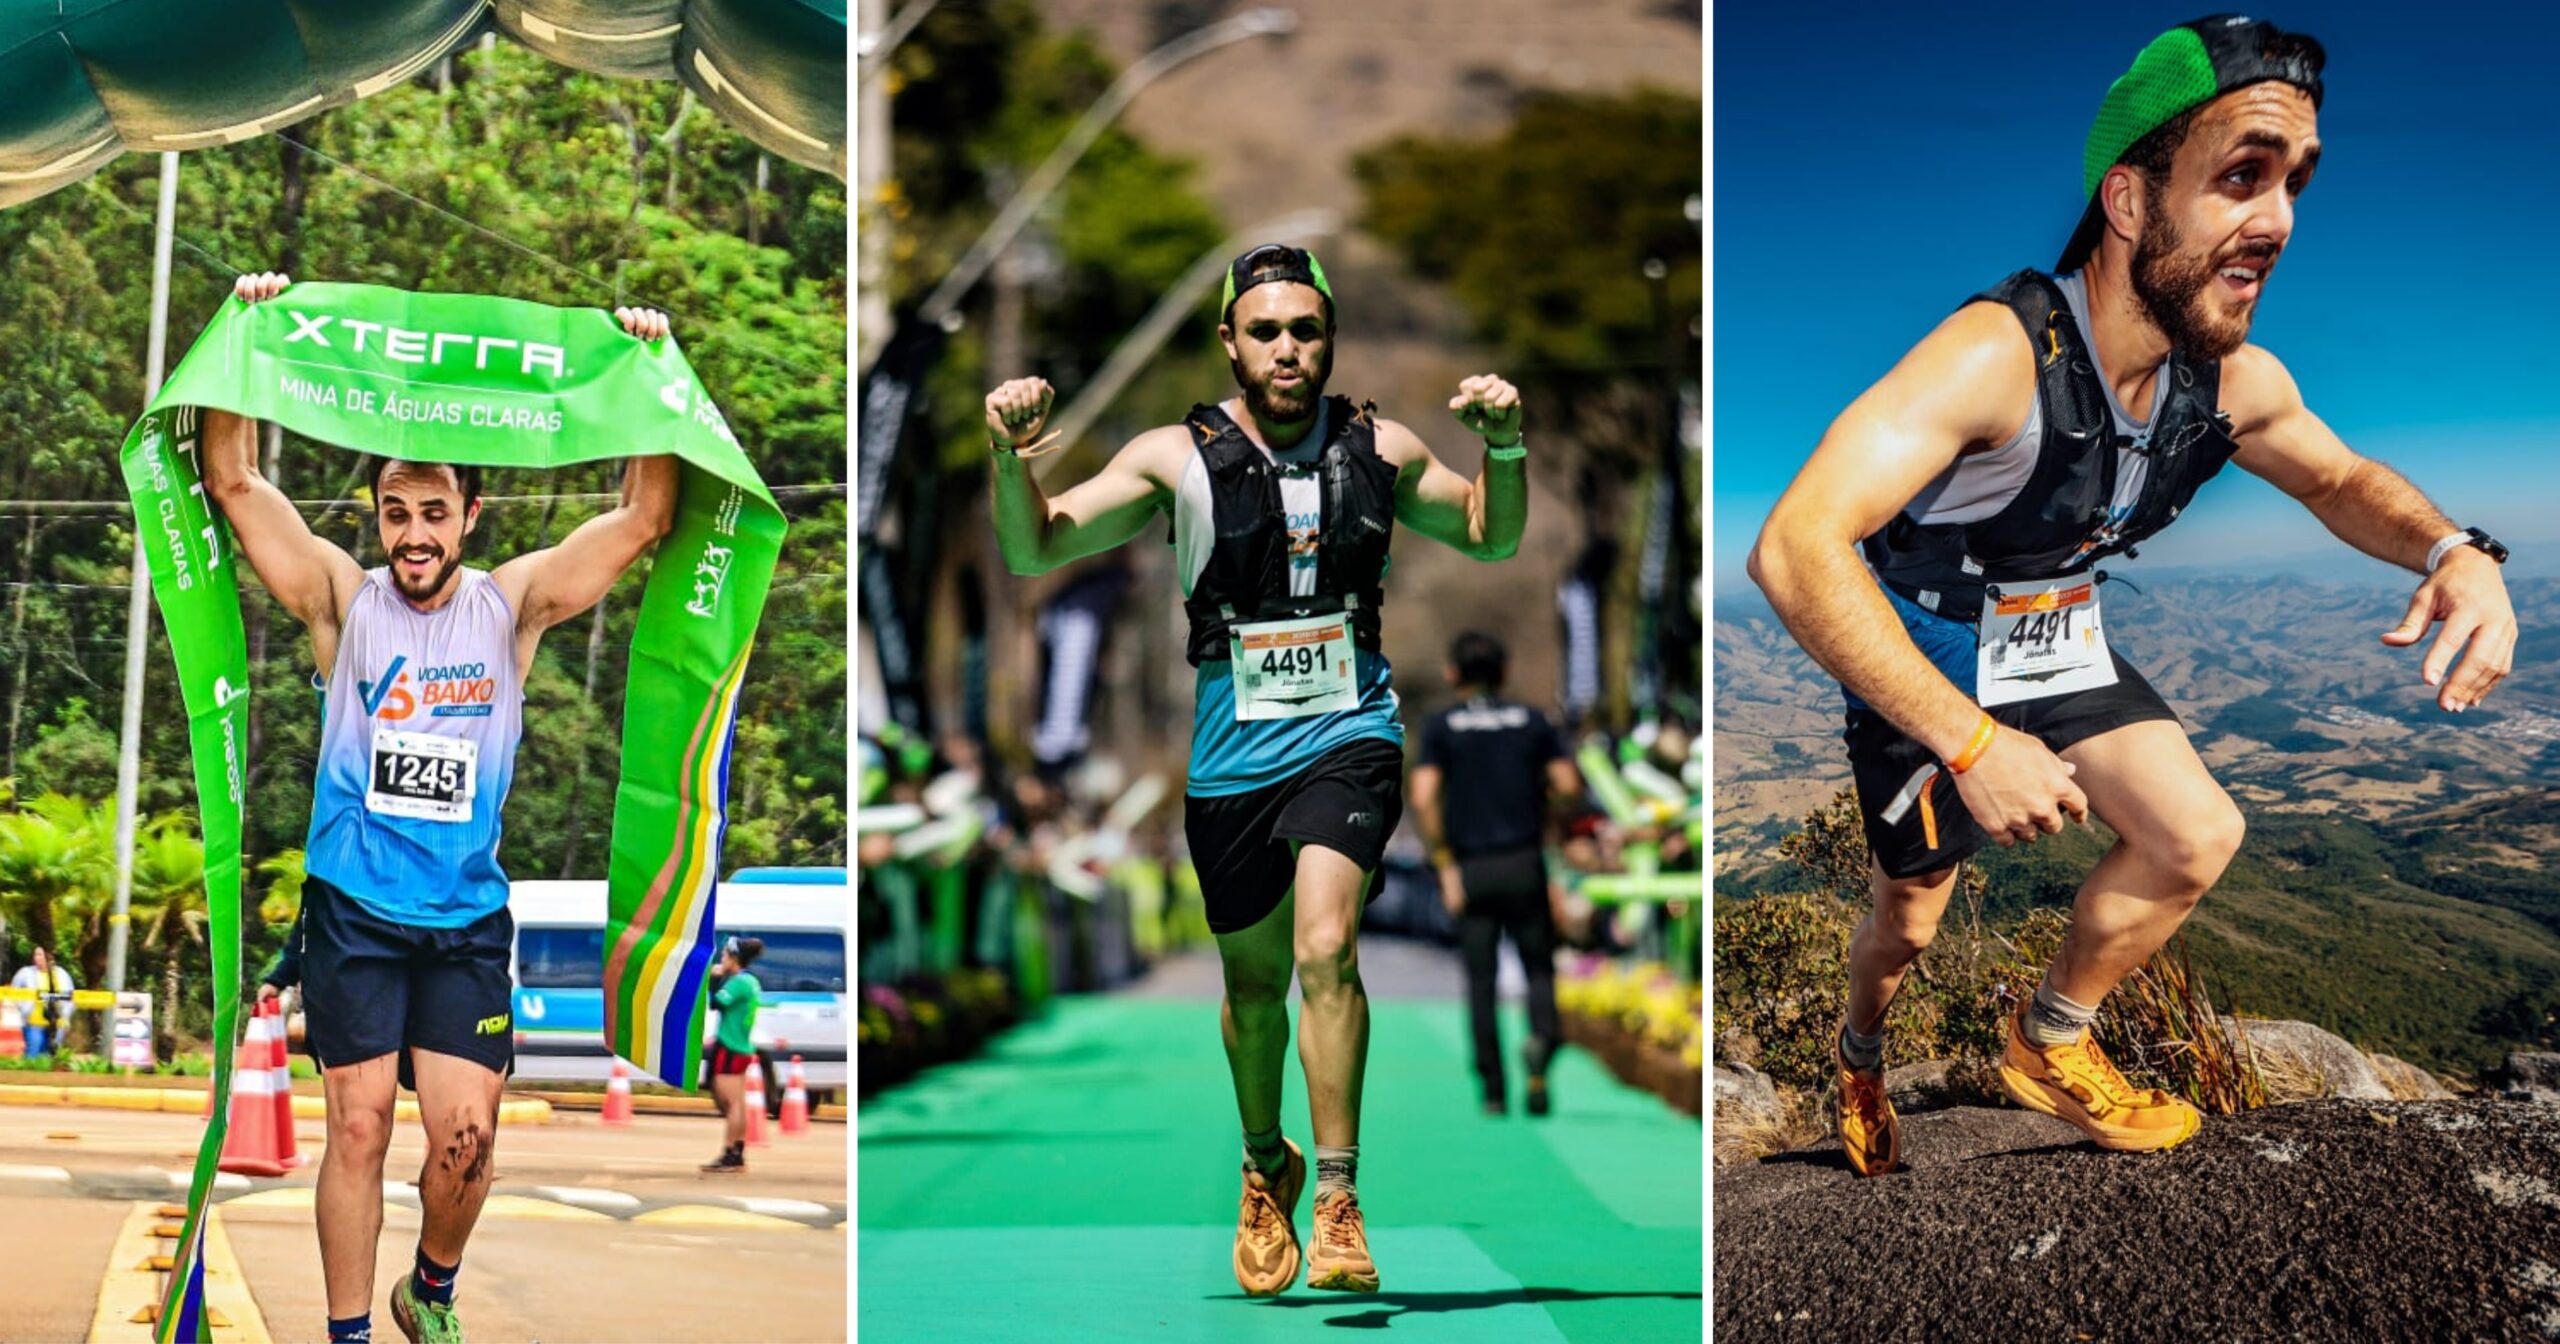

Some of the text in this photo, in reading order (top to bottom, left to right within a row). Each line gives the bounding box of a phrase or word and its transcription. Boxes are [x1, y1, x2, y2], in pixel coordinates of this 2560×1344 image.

[279, 376, 563, 433] MINA DE ÁGUAS CLARAS
[158, 497, 193, 591] CLARAS
[2007, 606, 2073, 649] 4491
[417, 662, 485, 682] VOANDO
[1260, 643, 1328, 677] 4491
[422, 677, 495, 705] BAIXO
[384, 754, 458, 793] 1245
